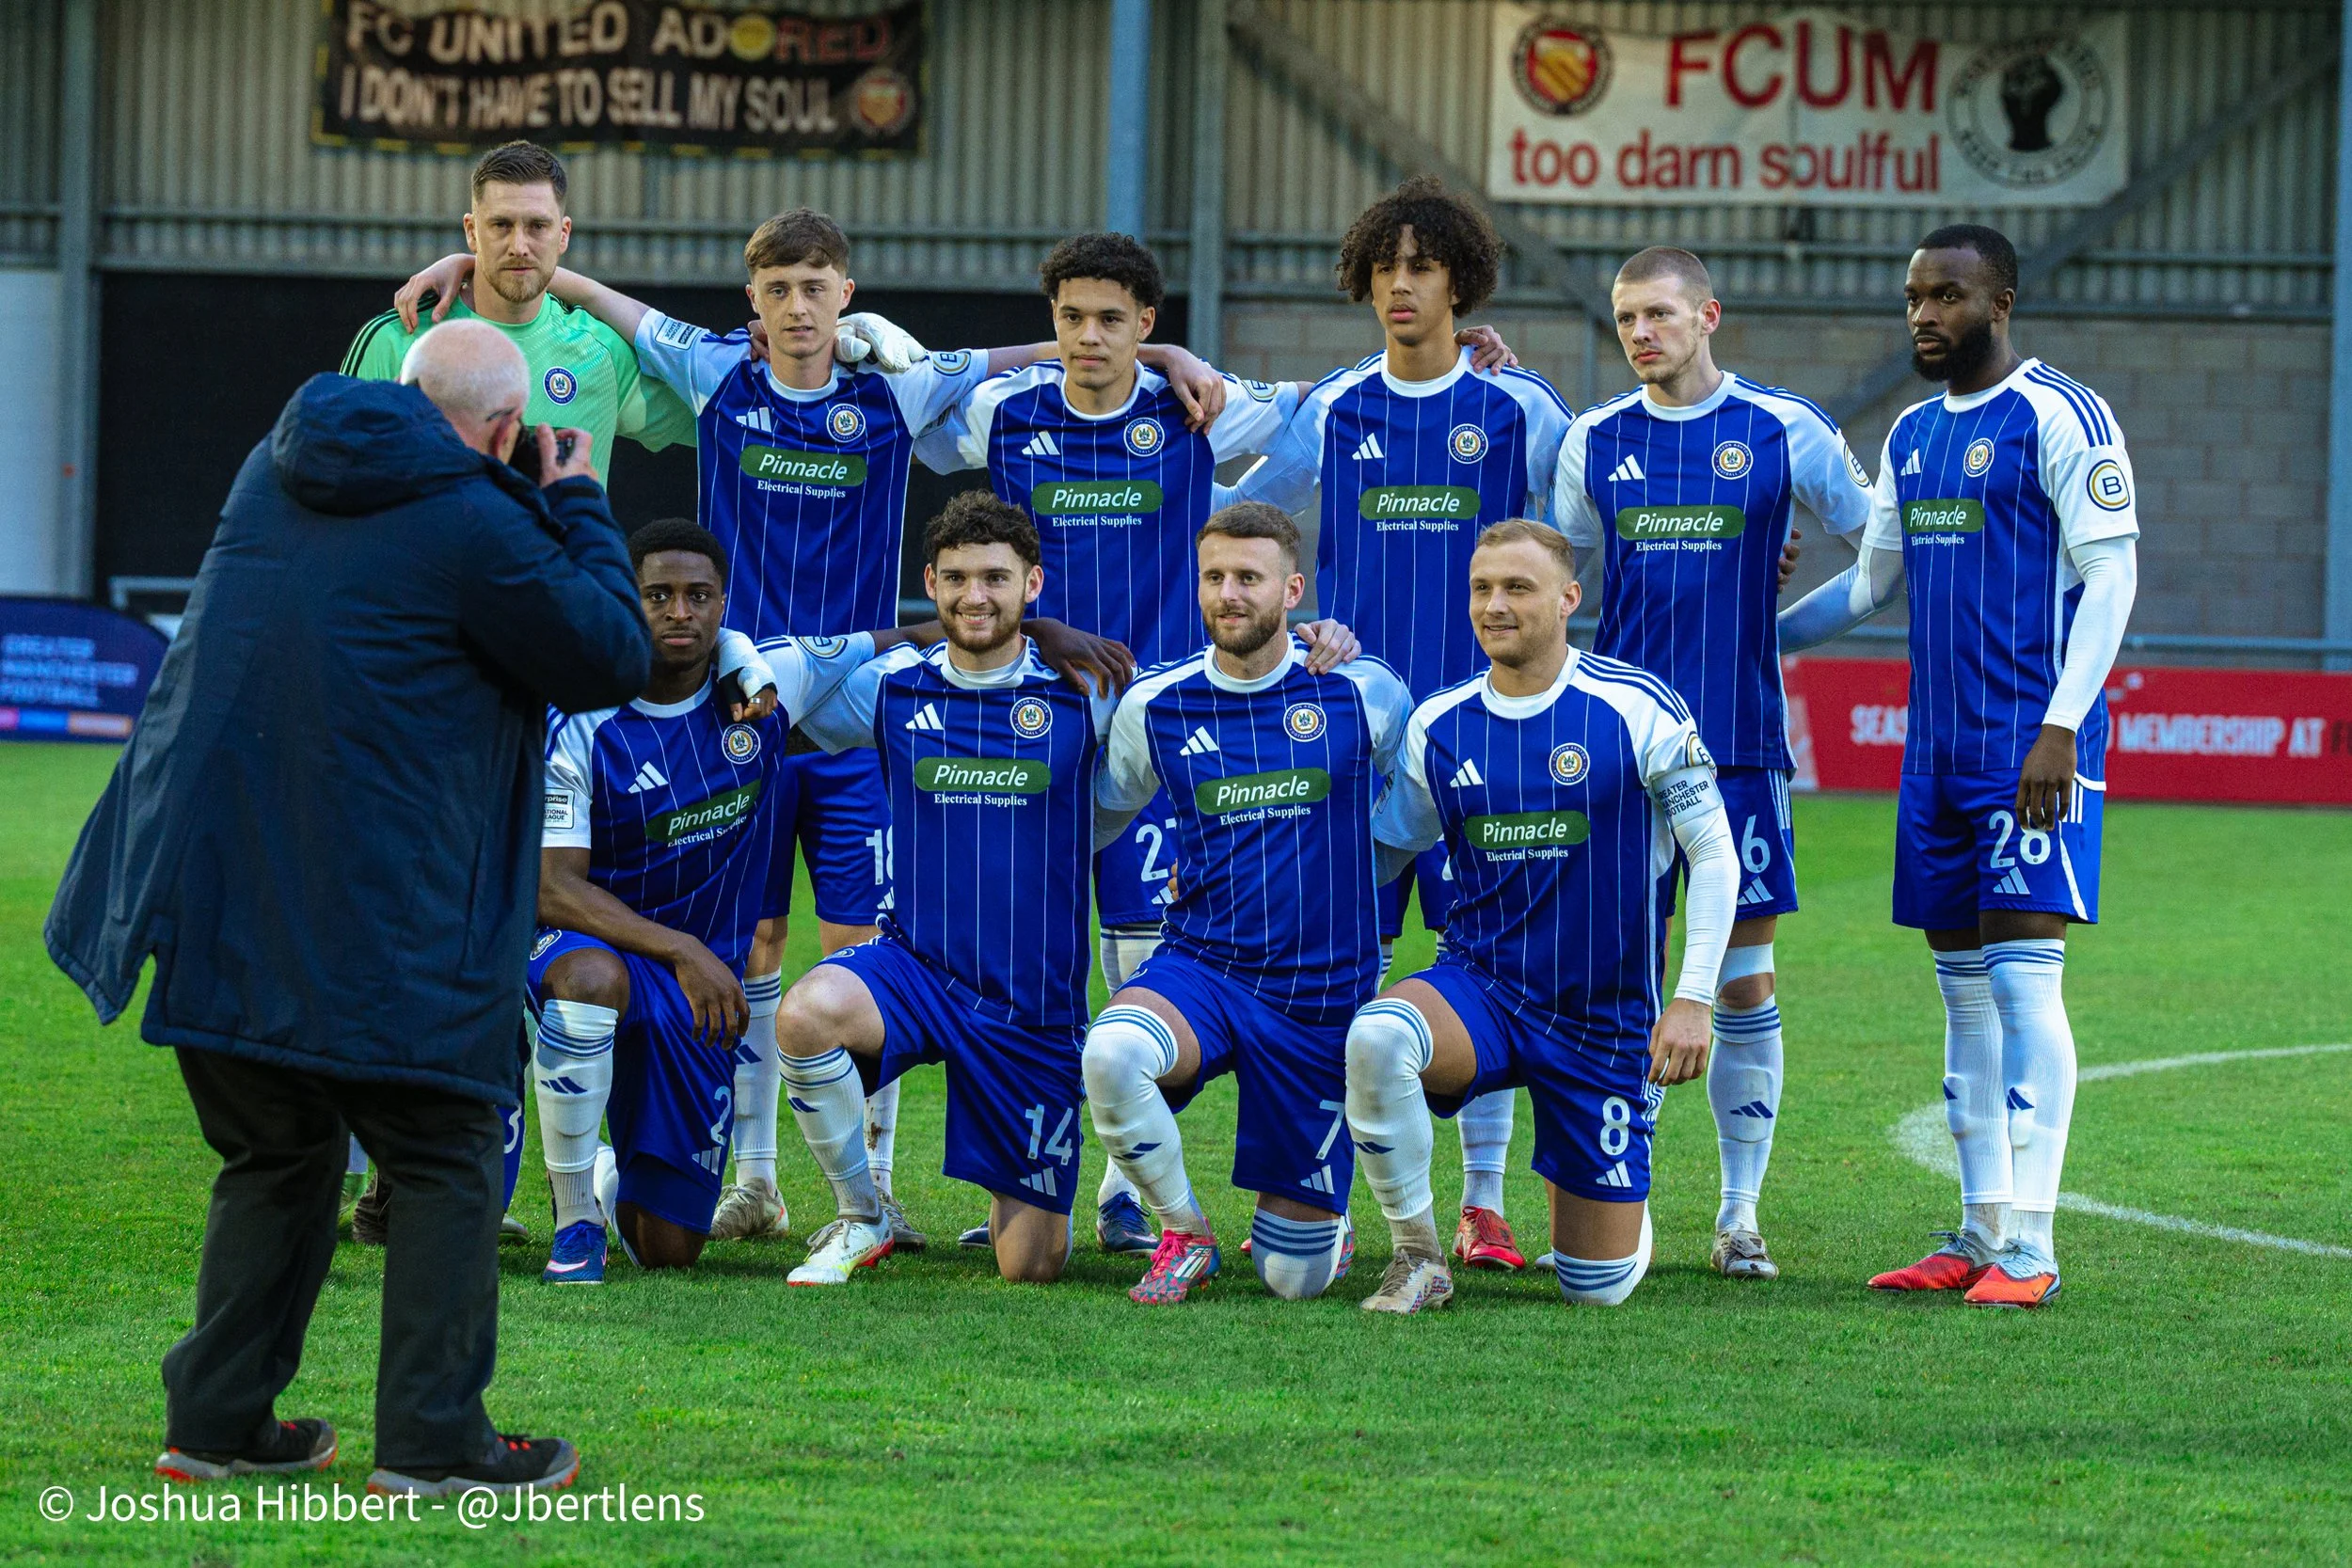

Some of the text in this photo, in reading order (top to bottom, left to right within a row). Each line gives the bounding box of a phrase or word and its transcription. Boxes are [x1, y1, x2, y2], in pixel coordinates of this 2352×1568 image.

[344, 1, 415, 56] FC
[427, 2, 629, 65] UNITED
[1663, 20, 1941, 113] FCUM
[339, 63, 357, 119] I
[468, 72, 552, 130] HAVE
[557, 68, 603, 127] TO
[607, 66, 683, 129] SELL
[687, 71, 743, 131] MY
[744, 75, 838, 134] SOUL
[1510, 128, 1942, 191] too darn soulful
[758, 452, 849, 481] Pinnacle
[756, 480, 846, 499] Electrical Supplies
[1050, 486, 1142, 509] Pinnacle
[2102, 476, 2122, 496] B
[1376, 492, 1461, 513] Pinnacle
[1051, 515, 1143, 529] Electrical Supplies
[1376, 520, 1459, 533] Electrical Supplies
[1633, 511, 1724, 533] Pinnacle
[1635, 539, 1723, 553] Electrical Supplies
[1851, 704, 1908, 747] SEAS
[2118, 712, 2285, 757] MEMBERSHIP
[2288, 716, 2326, 758] AT
[933, 764, 1028, 786] Pinnacle
[934, 793, 1027, 807] Electrical Supplies
[1216, 775, 1310, 807] Pinnacle
[667, 793, 750, 835] Pinnacle
[1219, 805, 1311, 826] Electrical Supplies
[1484, 816, 1567, 843] Pinnacle
[1136, 817, 1177, 882] 2
[1486, 847, 1568, 862] Electrical Supplies
[1740, 815, 1772, 874] 6
[710, 1085, 732, 1147] 2
[1318, 1100, 1345, 1161] 7
[1599, 1096, 1630, 1157] 8
[1025, 1104, 1073, 1166] 14
